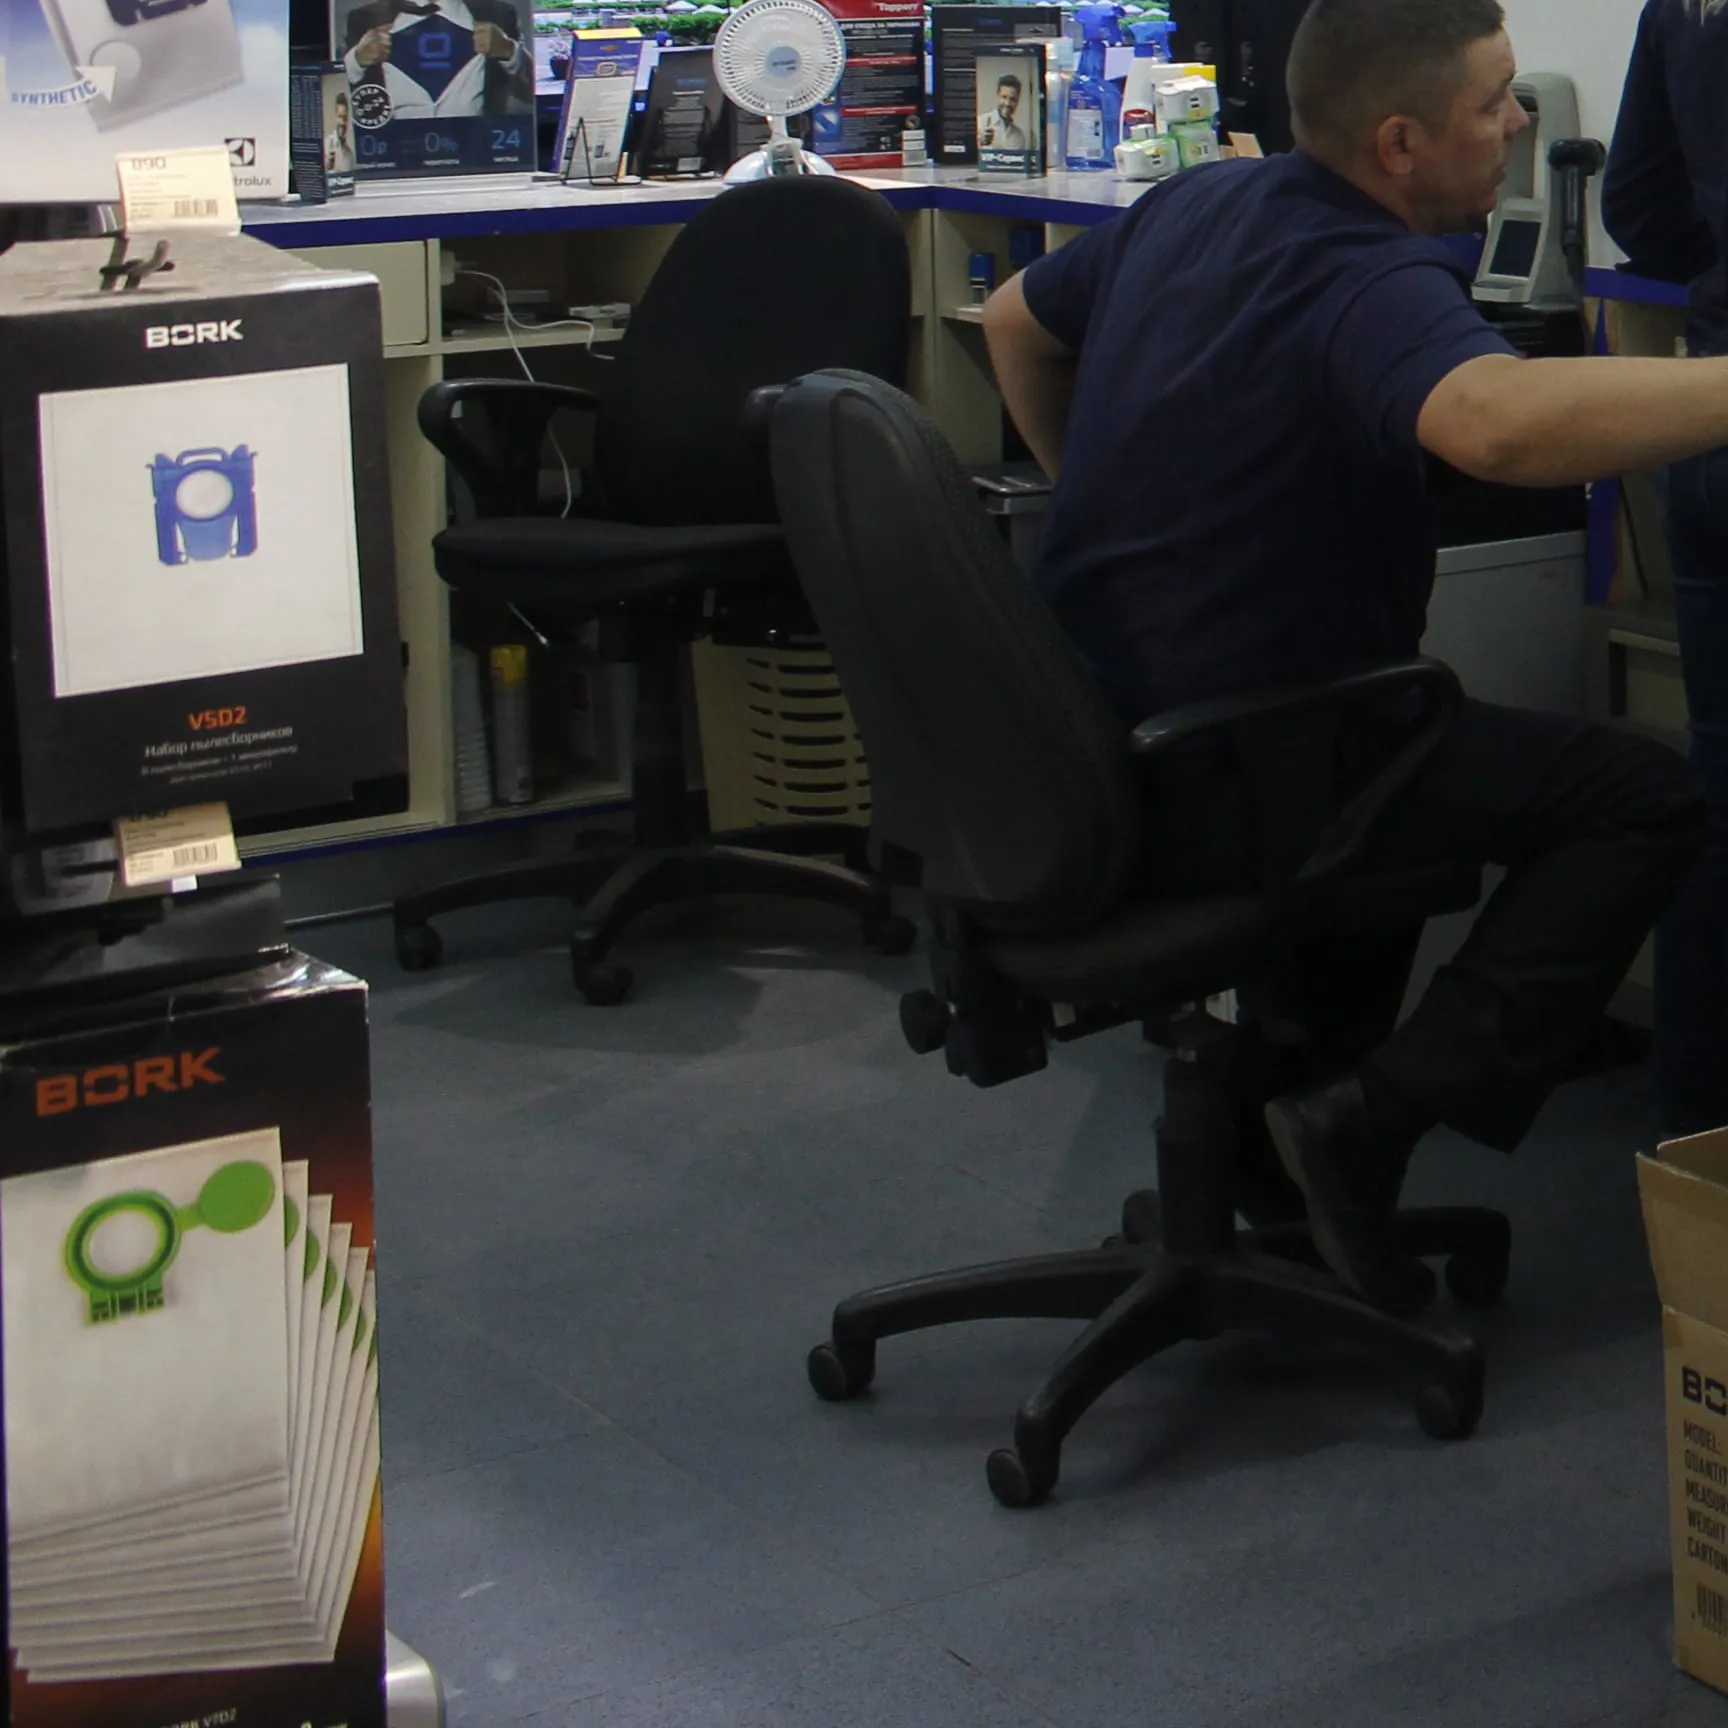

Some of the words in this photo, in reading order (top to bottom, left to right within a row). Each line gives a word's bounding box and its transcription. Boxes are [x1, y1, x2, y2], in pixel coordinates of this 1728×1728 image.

[11, 79, 98, 106] SYNTHETIC
[491, 129, 521, 150] 24
[234, 175, 273, 187] trolux
[145, 318, 243, 349] BORK
[144, 742, 188, 759] Набор
[36, 1047, 226, 1117] BORK
